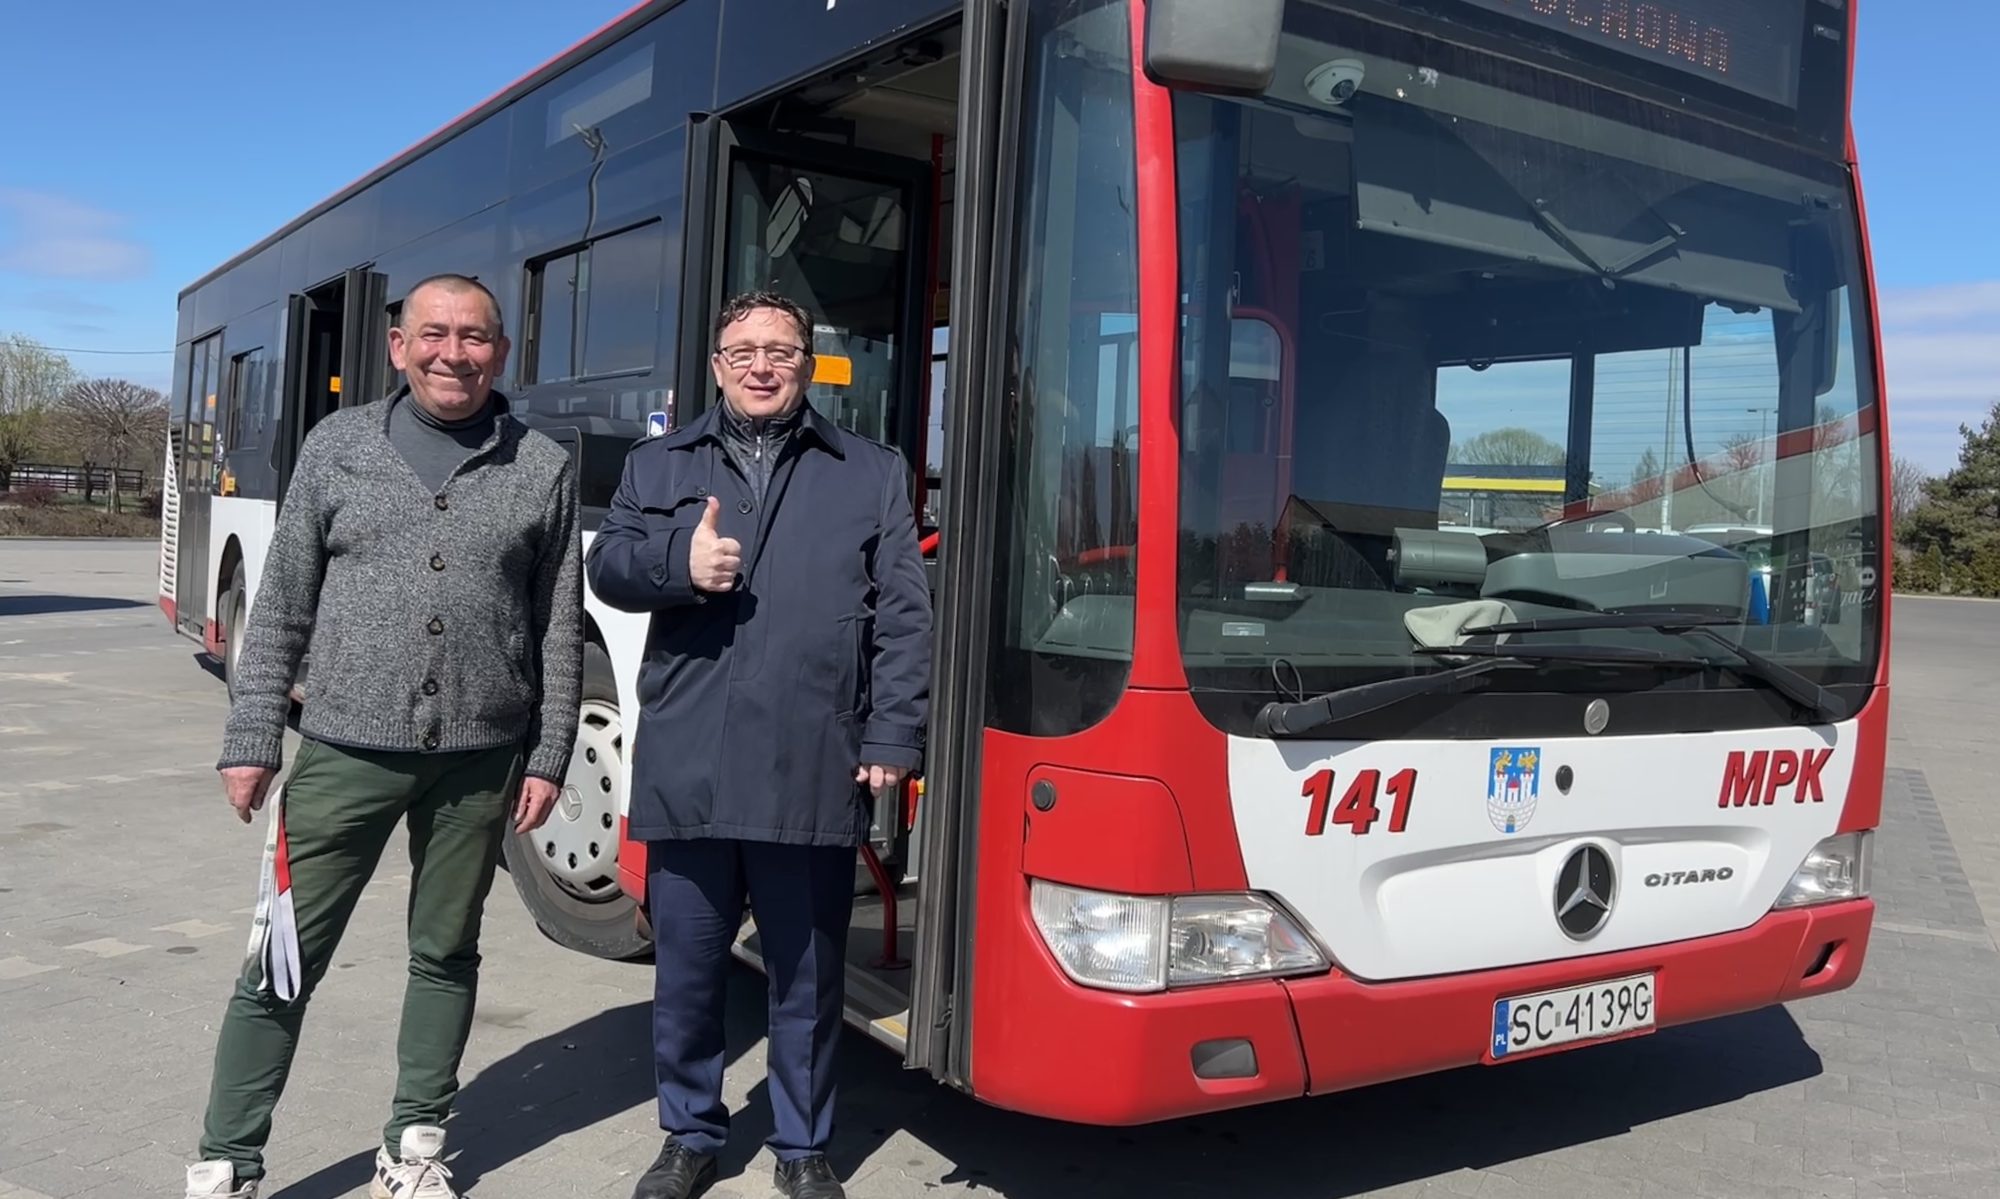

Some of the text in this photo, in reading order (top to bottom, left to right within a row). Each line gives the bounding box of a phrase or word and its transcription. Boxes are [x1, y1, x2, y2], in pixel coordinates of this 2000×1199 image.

[1301, 768, 1418, 836] 141
[1718, 748, 1834, 808] MPK
[1495, 1033, 1507, 1047] PL
[1512, 982, 1649, 1046] SC 4139G
